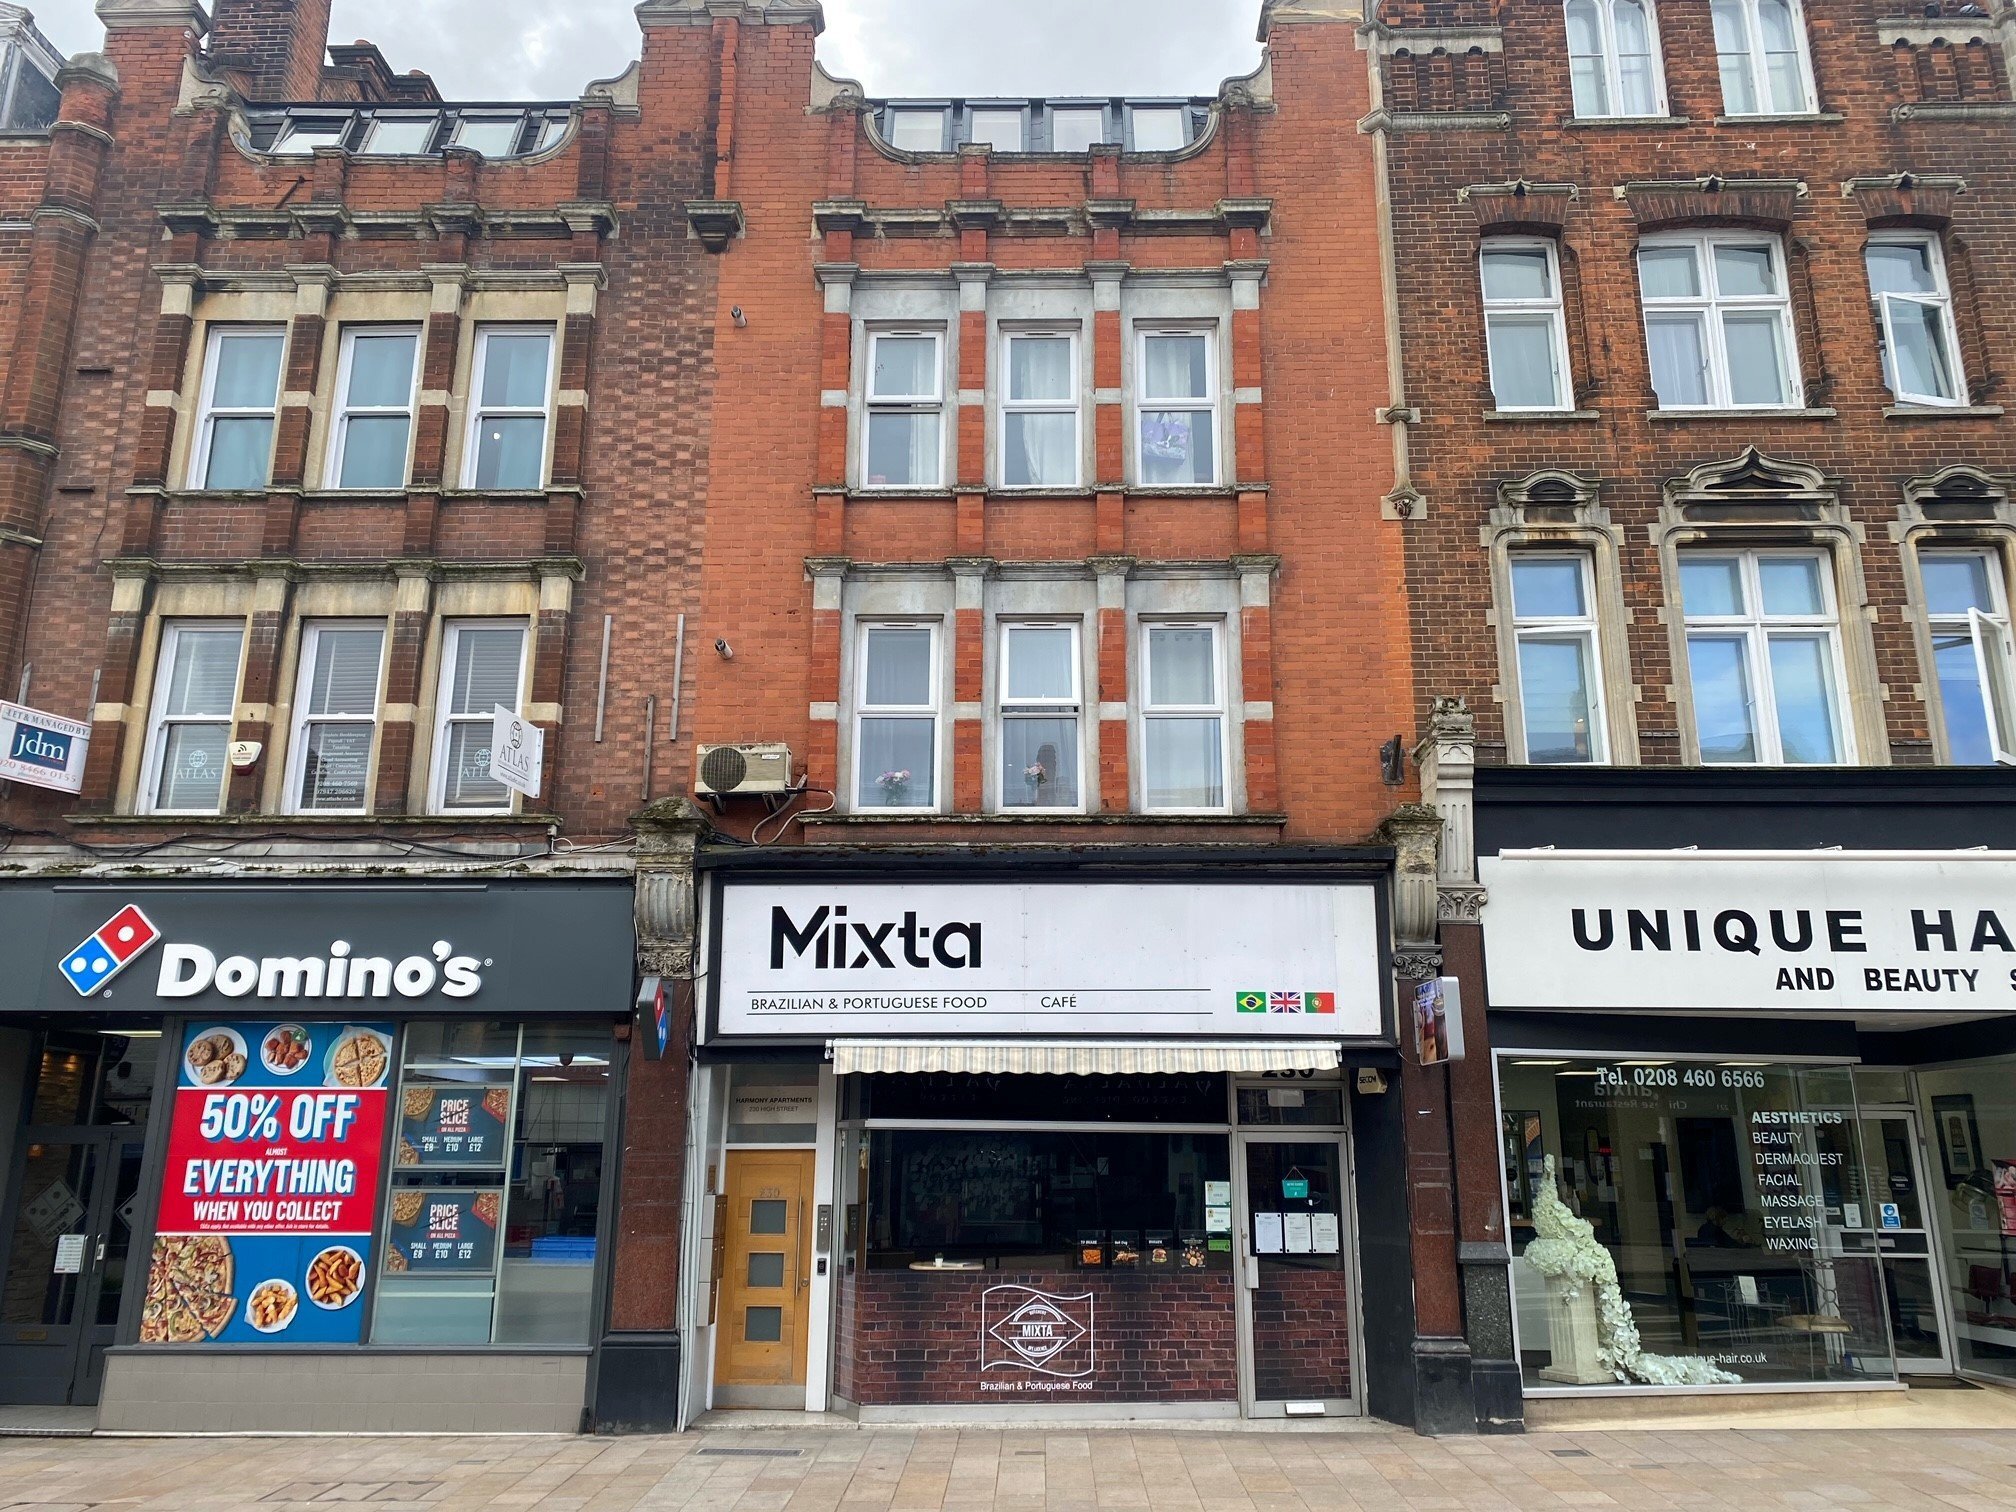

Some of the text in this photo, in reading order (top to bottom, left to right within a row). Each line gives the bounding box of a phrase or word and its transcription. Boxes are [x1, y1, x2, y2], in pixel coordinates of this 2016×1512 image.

[23, 713, 30, 722] &
[32, 715, 75, 733] MANAGED
[13, 727, 65, 761] jdm
[499, 744, 530, 772] ATLAS
[0, 760, 17, 769] 20
[20, 764, 47, 776] 8466
[50, 770, 77, 783] 0155
[175, 768, 218, 779] ATLAS
[770, 905, 983, 970] Mixta
[1571, 909, 2016, 956] UNIQUE HA
[155, 939, 482, 998] Domino's
[1776, 967, 1980, 992] AND BEAUTY
[751, 997, 988, 1010] BRAZILIAN & PORTUGUESE FOOD
[1040, 994, 1077, 1009] CAFÉ
[1597, 1067, 1765, 1089] Tel. 0208 460 6566
[441, 1099, 470, 1112] PRICE
[200, 1093, 358, 1141] 50% OFF
[440, 1112, 469, 1124] SLICE
[1752, 1111, 1842, 1125] AESTHETICS
[1752, 1132, 1802, 1144] BEAUTY
[265, 1148, 287, 1156] ALMOST
[424, 1143, 482, 1152] £8 £10 £12
[1755, 1153, 1843, 1165] DERMAQUEST
[183, 1159, 356, 1196] EVERYTHING
[1758, 1174, 1802, 1186] FACIAL
[1761, 1195, 1824, 1207] MASSAGE
[193, 1201, 342, 1221] WHEN YOU COLLECT
[430, 1204, 459, 1217] PRICE
[429, 1217, 458, 1230] SLICE
[1764, 1216, 1822, 1229] EYELASH
[1766, 1238, 1819, 1250] WAXING
[413, 1250, 472, 1259] £8 £10 £12
[1022, 1324, 1053, 1337] MIXTA
[980, 1381, 1093, 1392] Brazilian & Portuguese Food
